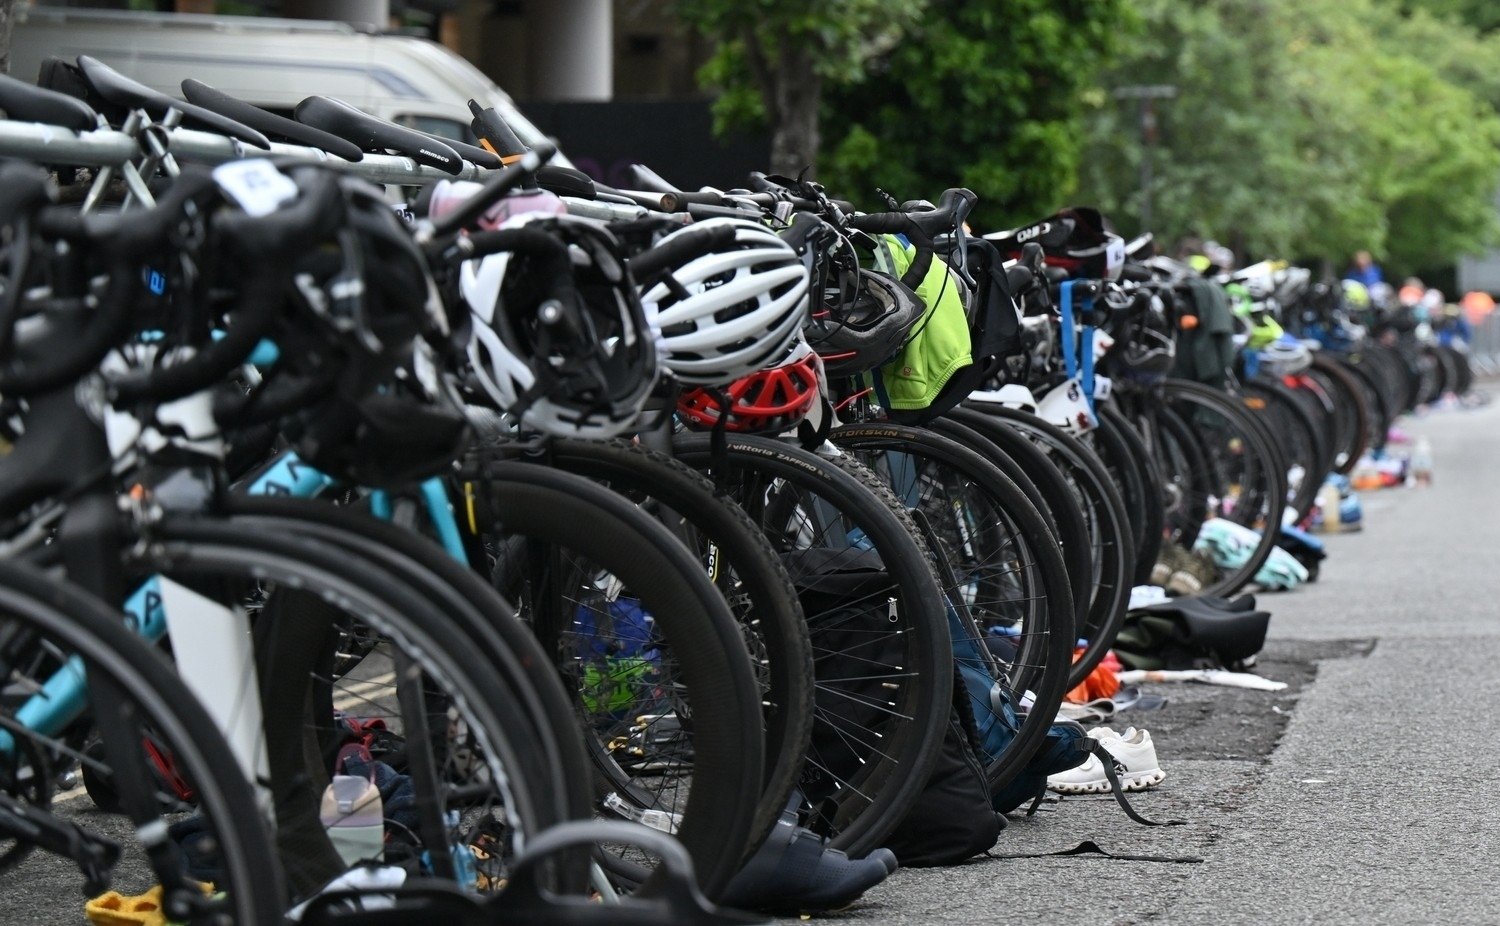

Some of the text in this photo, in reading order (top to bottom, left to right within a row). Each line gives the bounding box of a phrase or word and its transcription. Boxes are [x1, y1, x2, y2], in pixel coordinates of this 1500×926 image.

[420, 148, 450, 163] ammaco
[828, 429, 898, 440] ATORSKIN
[731, 444, 773, 456] vittoria
